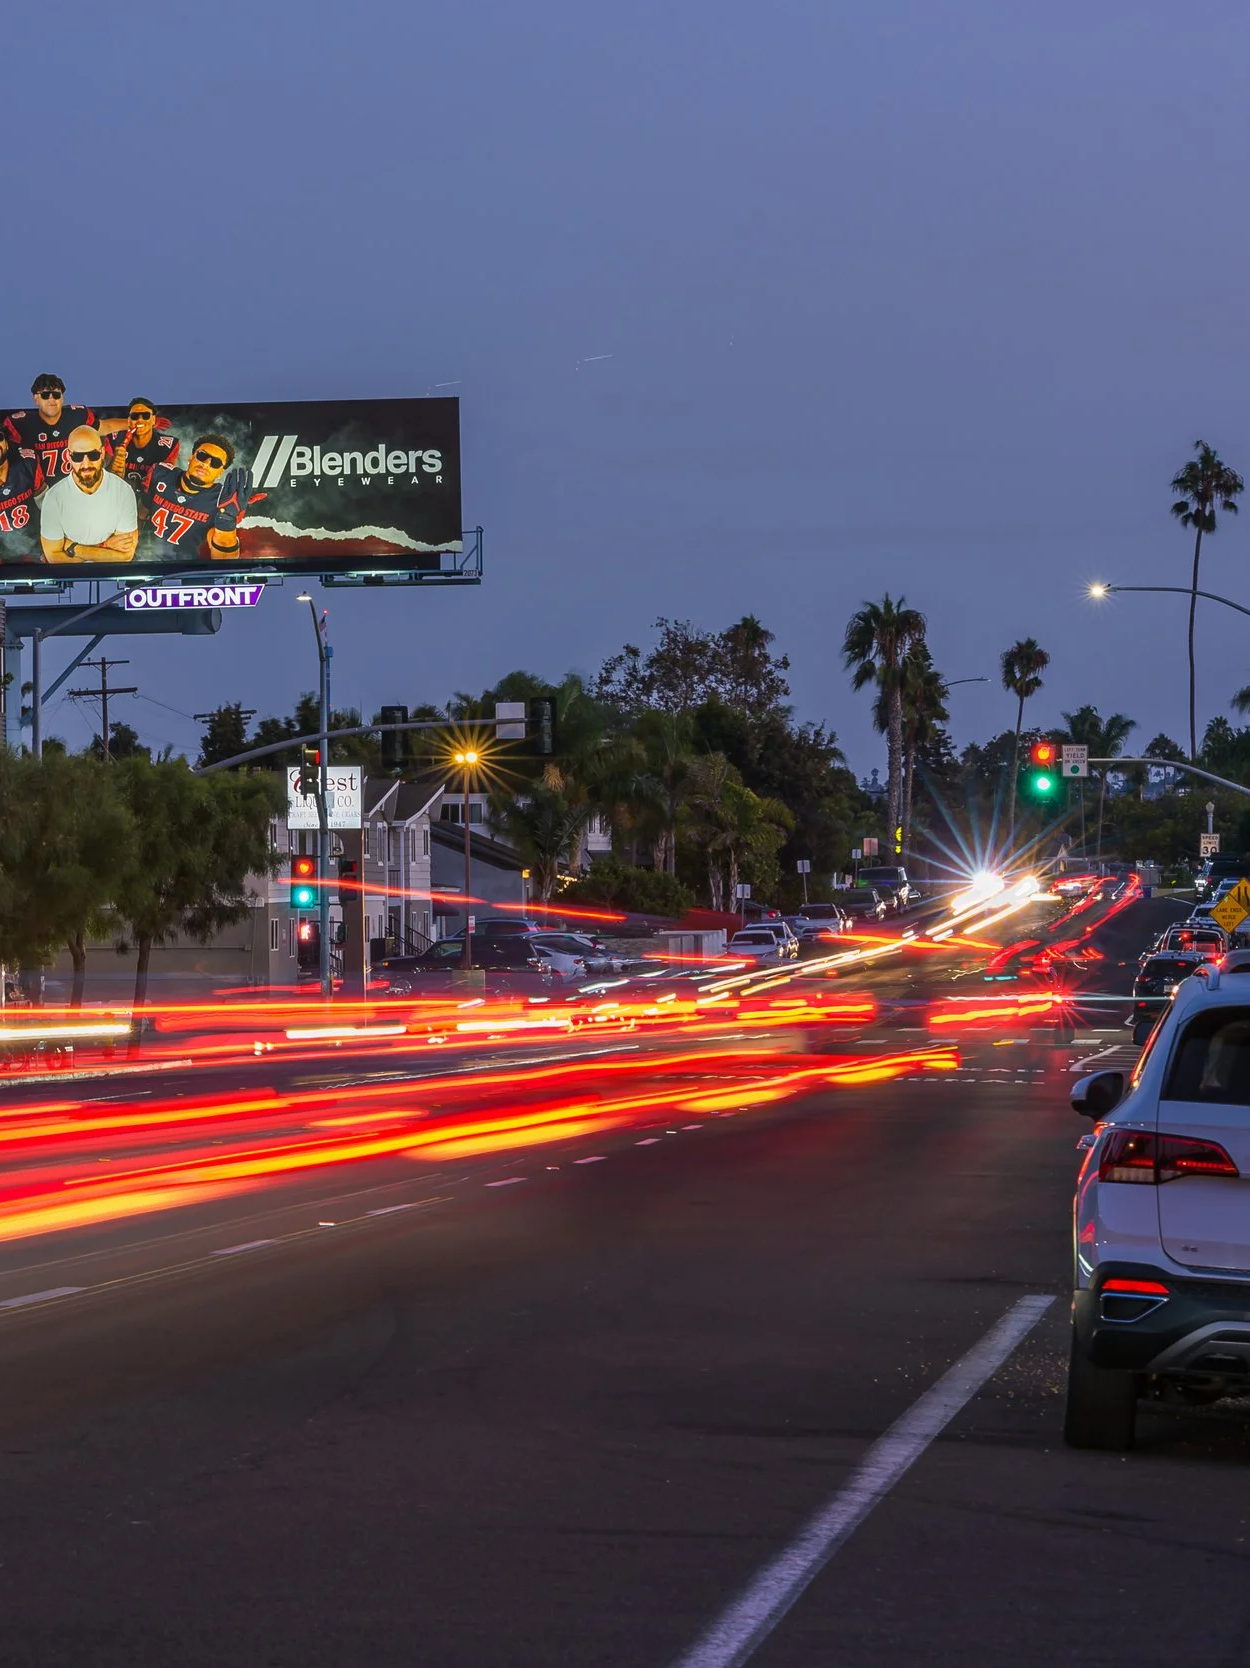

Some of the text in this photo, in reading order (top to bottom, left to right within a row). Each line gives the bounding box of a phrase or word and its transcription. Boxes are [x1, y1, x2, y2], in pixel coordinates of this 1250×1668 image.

[290, 443, 442, 476] Blenders
[290, 475, 443, 488] EYEWEAR
[162, 501, 185, 515] DIEGO
[184, 508, 210, 523] STATE
[151, 507, 195, 545] 47
[129, 587, 257, 608] OUTFRONT
[290, 769, 358, 794] est
[337, 795, 354, 808] CO.
[1202, 846, 1217, 854] 30
